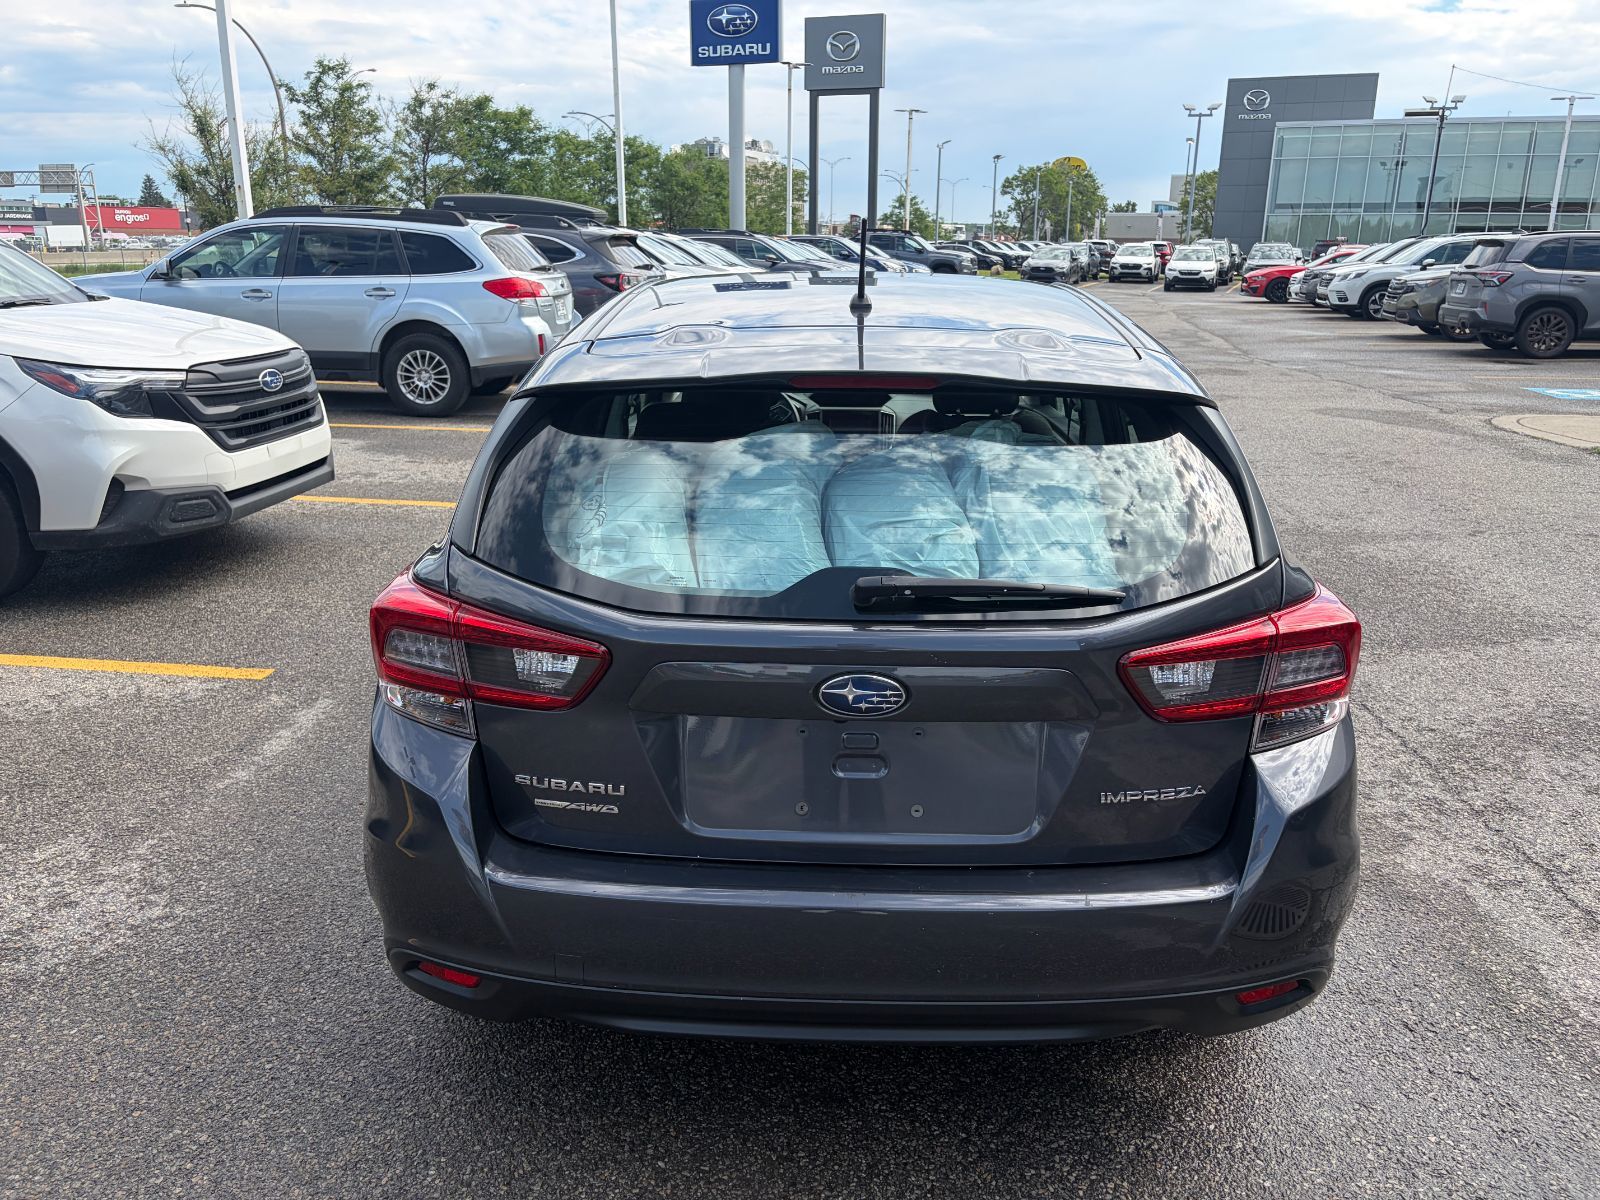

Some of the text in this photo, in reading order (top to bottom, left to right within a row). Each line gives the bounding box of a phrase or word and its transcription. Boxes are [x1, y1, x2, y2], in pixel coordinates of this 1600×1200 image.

[698, 42, 771, 58] SUBARU
[514, 774, 625, 796] SUBARU
[1100, 785, 1207, 804] IMPREZA
[565, 802, 619, 814] AWD
